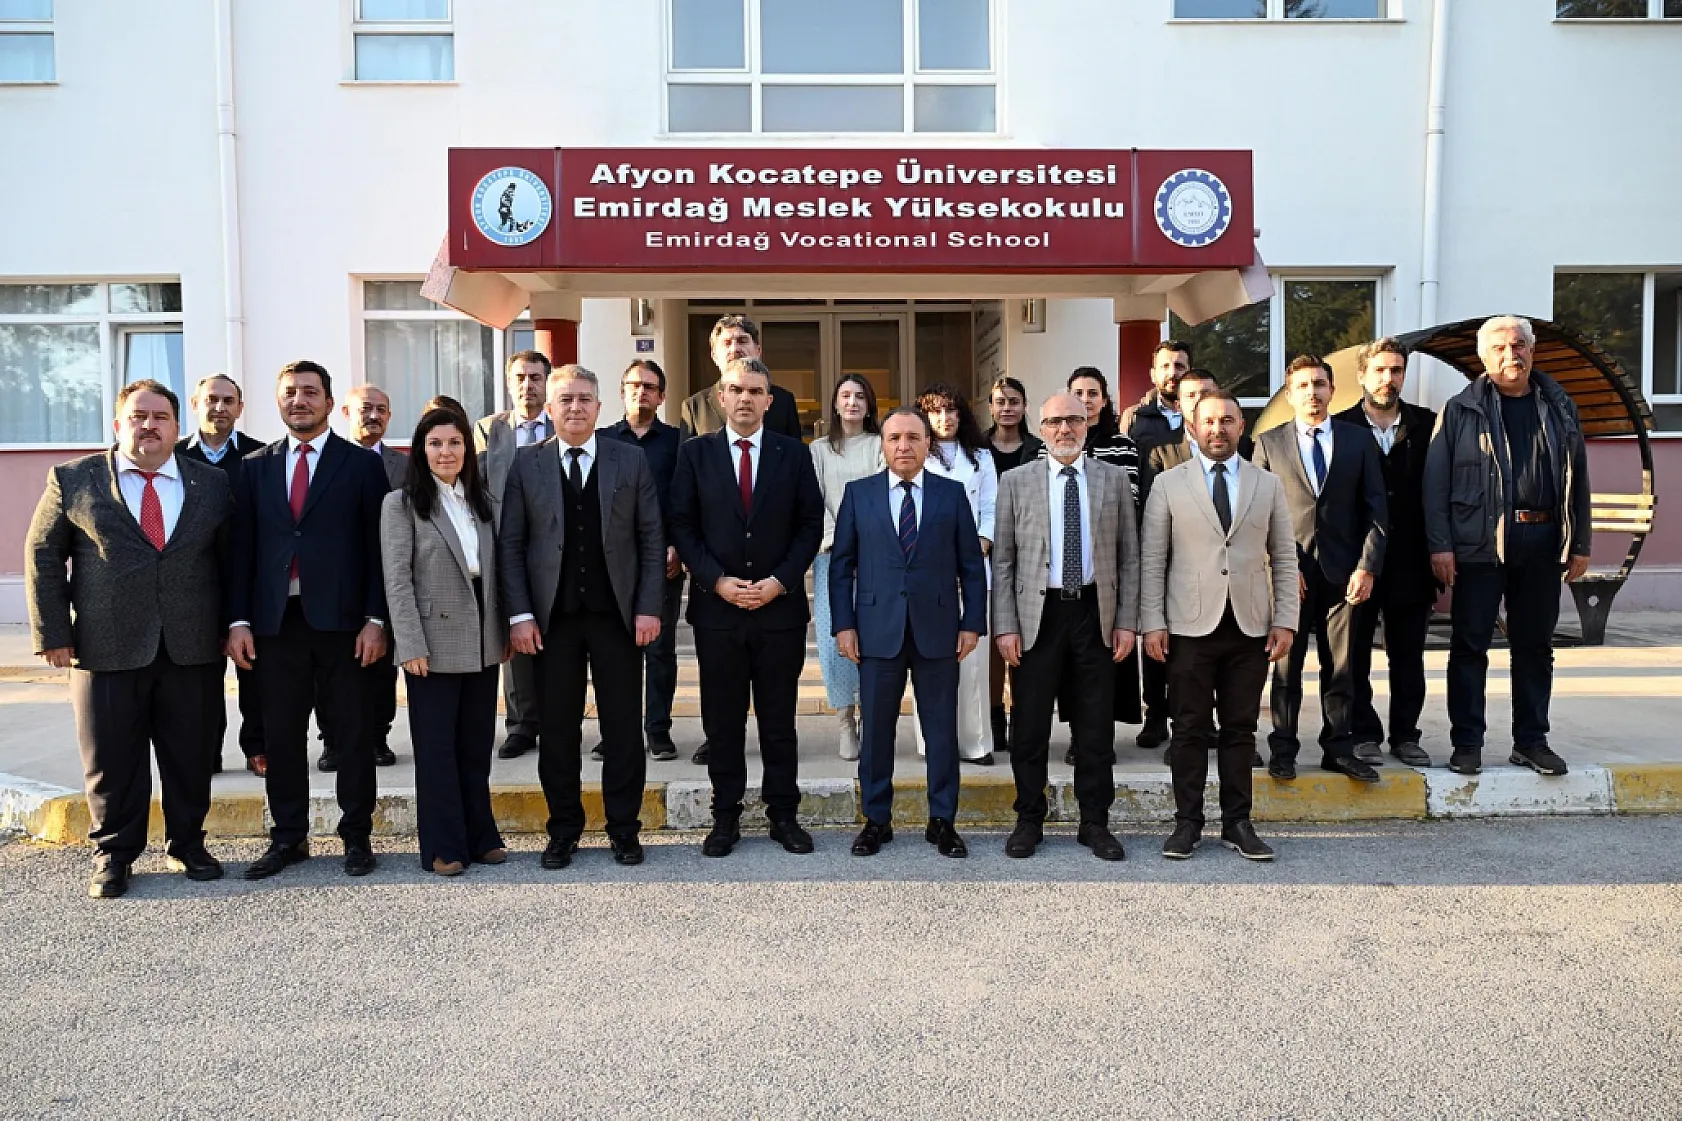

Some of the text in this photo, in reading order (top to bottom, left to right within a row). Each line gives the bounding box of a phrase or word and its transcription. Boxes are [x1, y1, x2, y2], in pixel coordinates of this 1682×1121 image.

[589, 157, 1116, 189] Afyon Kocatepe Üniversitesi
[573, 197, 1124, 223] Emirdağ Meslek Yüksekokulu
[645, 231, 1049, 251] Emirdağ Vocational School
